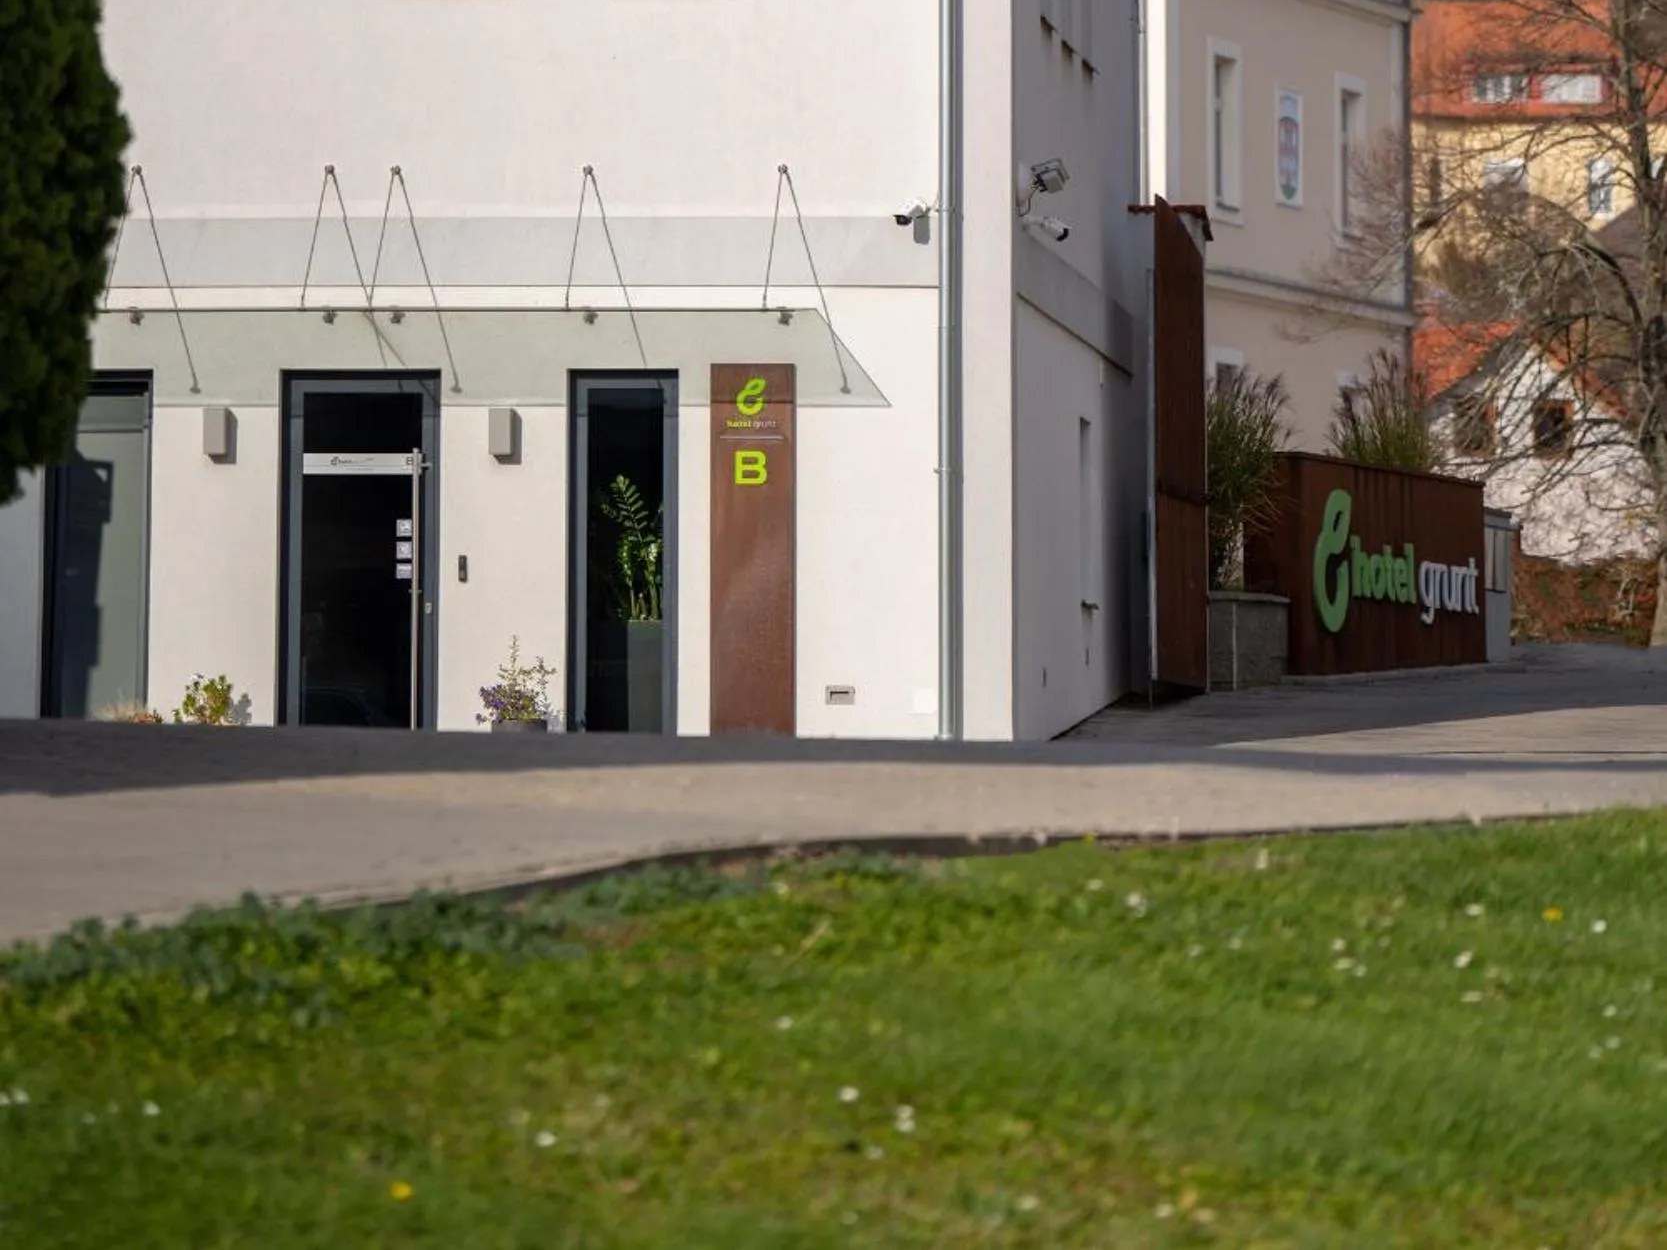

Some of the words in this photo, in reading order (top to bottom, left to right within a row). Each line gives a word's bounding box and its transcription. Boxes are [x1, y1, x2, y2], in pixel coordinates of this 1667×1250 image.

[735, 451, 768, 484] B
[1351, 534, 1417, 605] hotel
[1419, 557, 1480, 625] grunt
